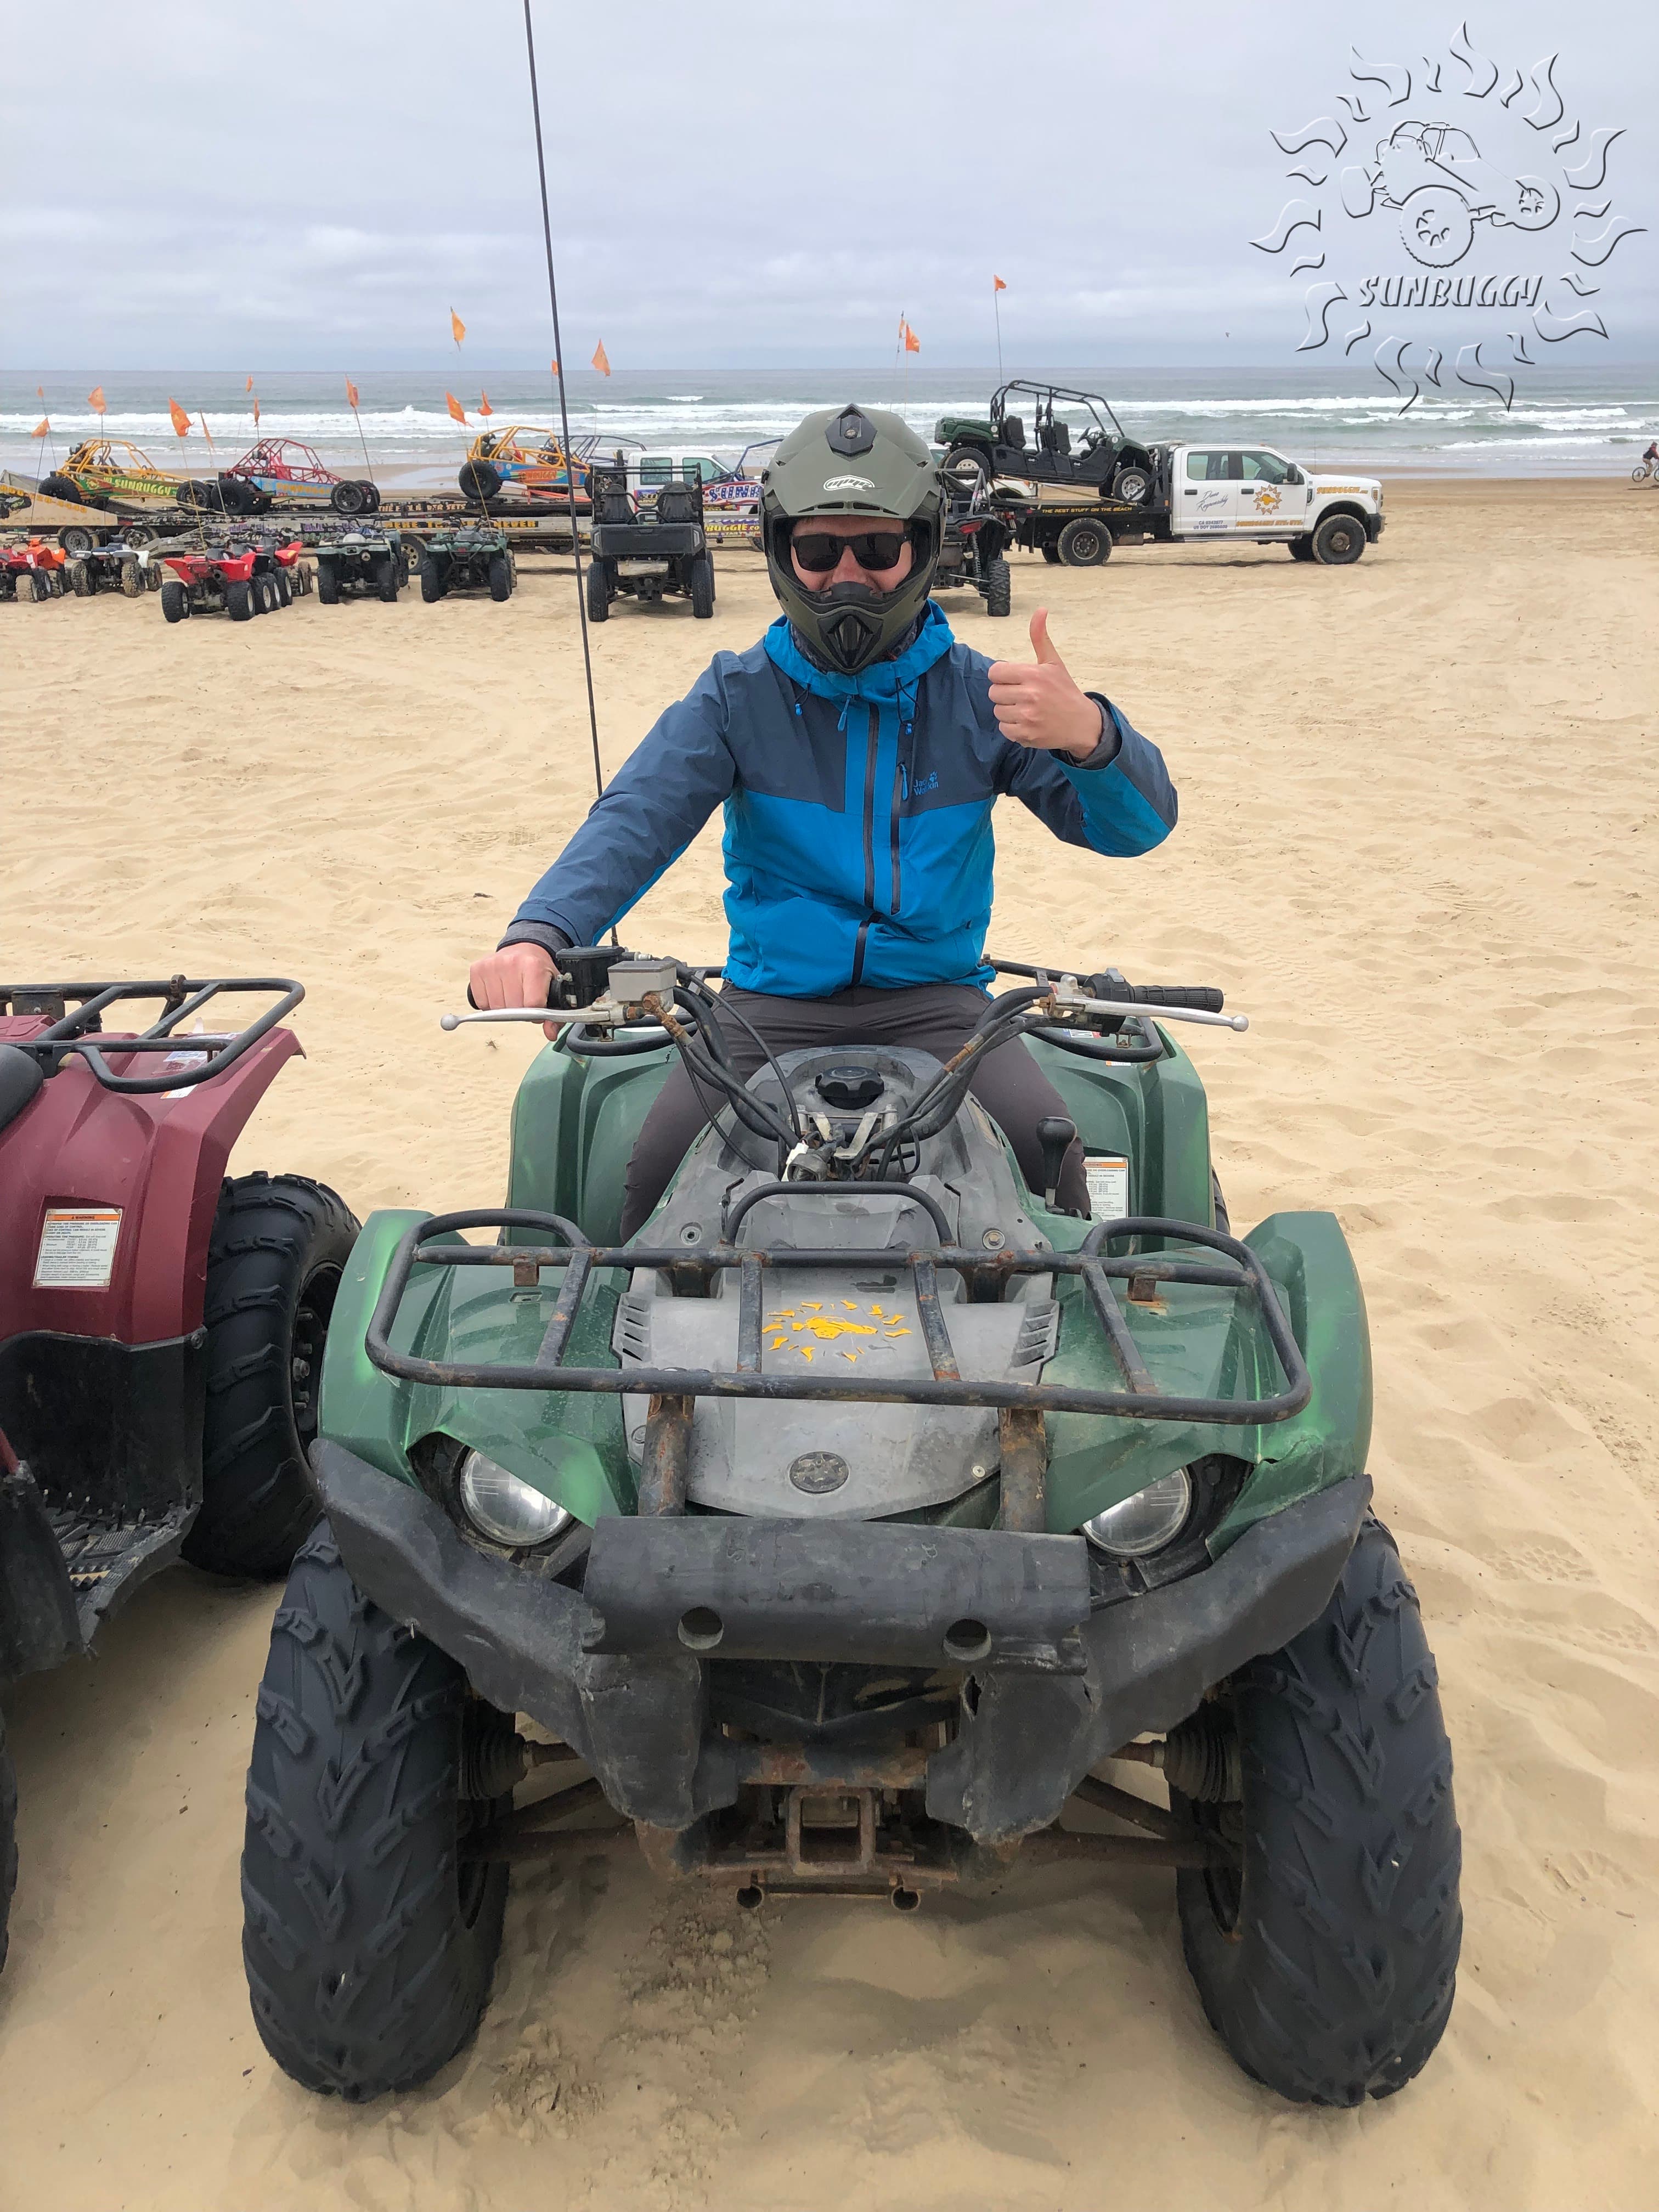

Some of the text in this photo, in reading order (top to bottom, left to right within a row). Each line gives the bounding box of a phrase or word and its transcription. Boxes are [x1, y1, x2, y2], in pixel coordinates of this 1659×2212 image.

[115, 479, 172, 495] SUNBUGGY
[913, 779, 928, 788] Jac
[913, 781, 939, 795] Wokin
